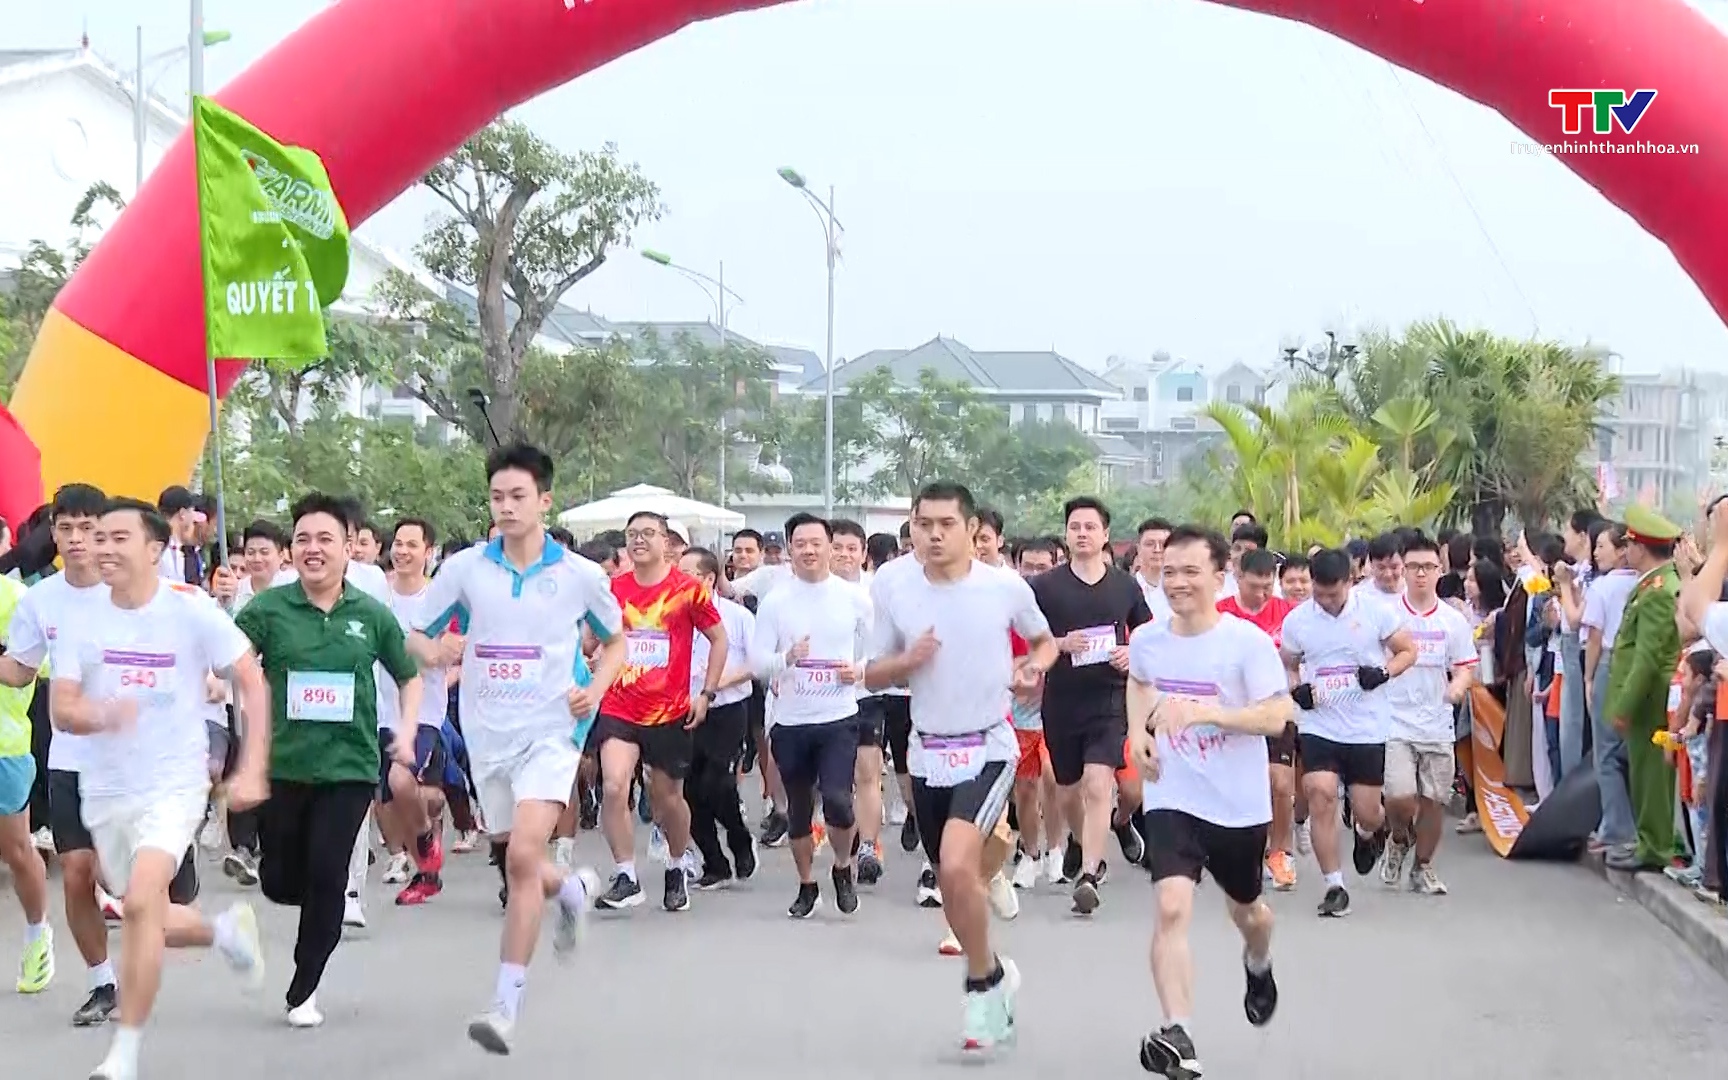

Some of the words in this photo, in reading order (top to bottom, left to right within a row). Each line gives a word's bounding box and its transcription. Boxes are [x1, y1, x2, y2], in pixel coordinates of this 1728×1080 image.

[226, 266, 298, 316] QUYẾT
[633, 641, 657, 653] 708
[489, 663, 522, 680] 688
[806, 671, 832, 684] 703
[303, 687, 336, 704] 896
[938, 751, 970, 768] 704
